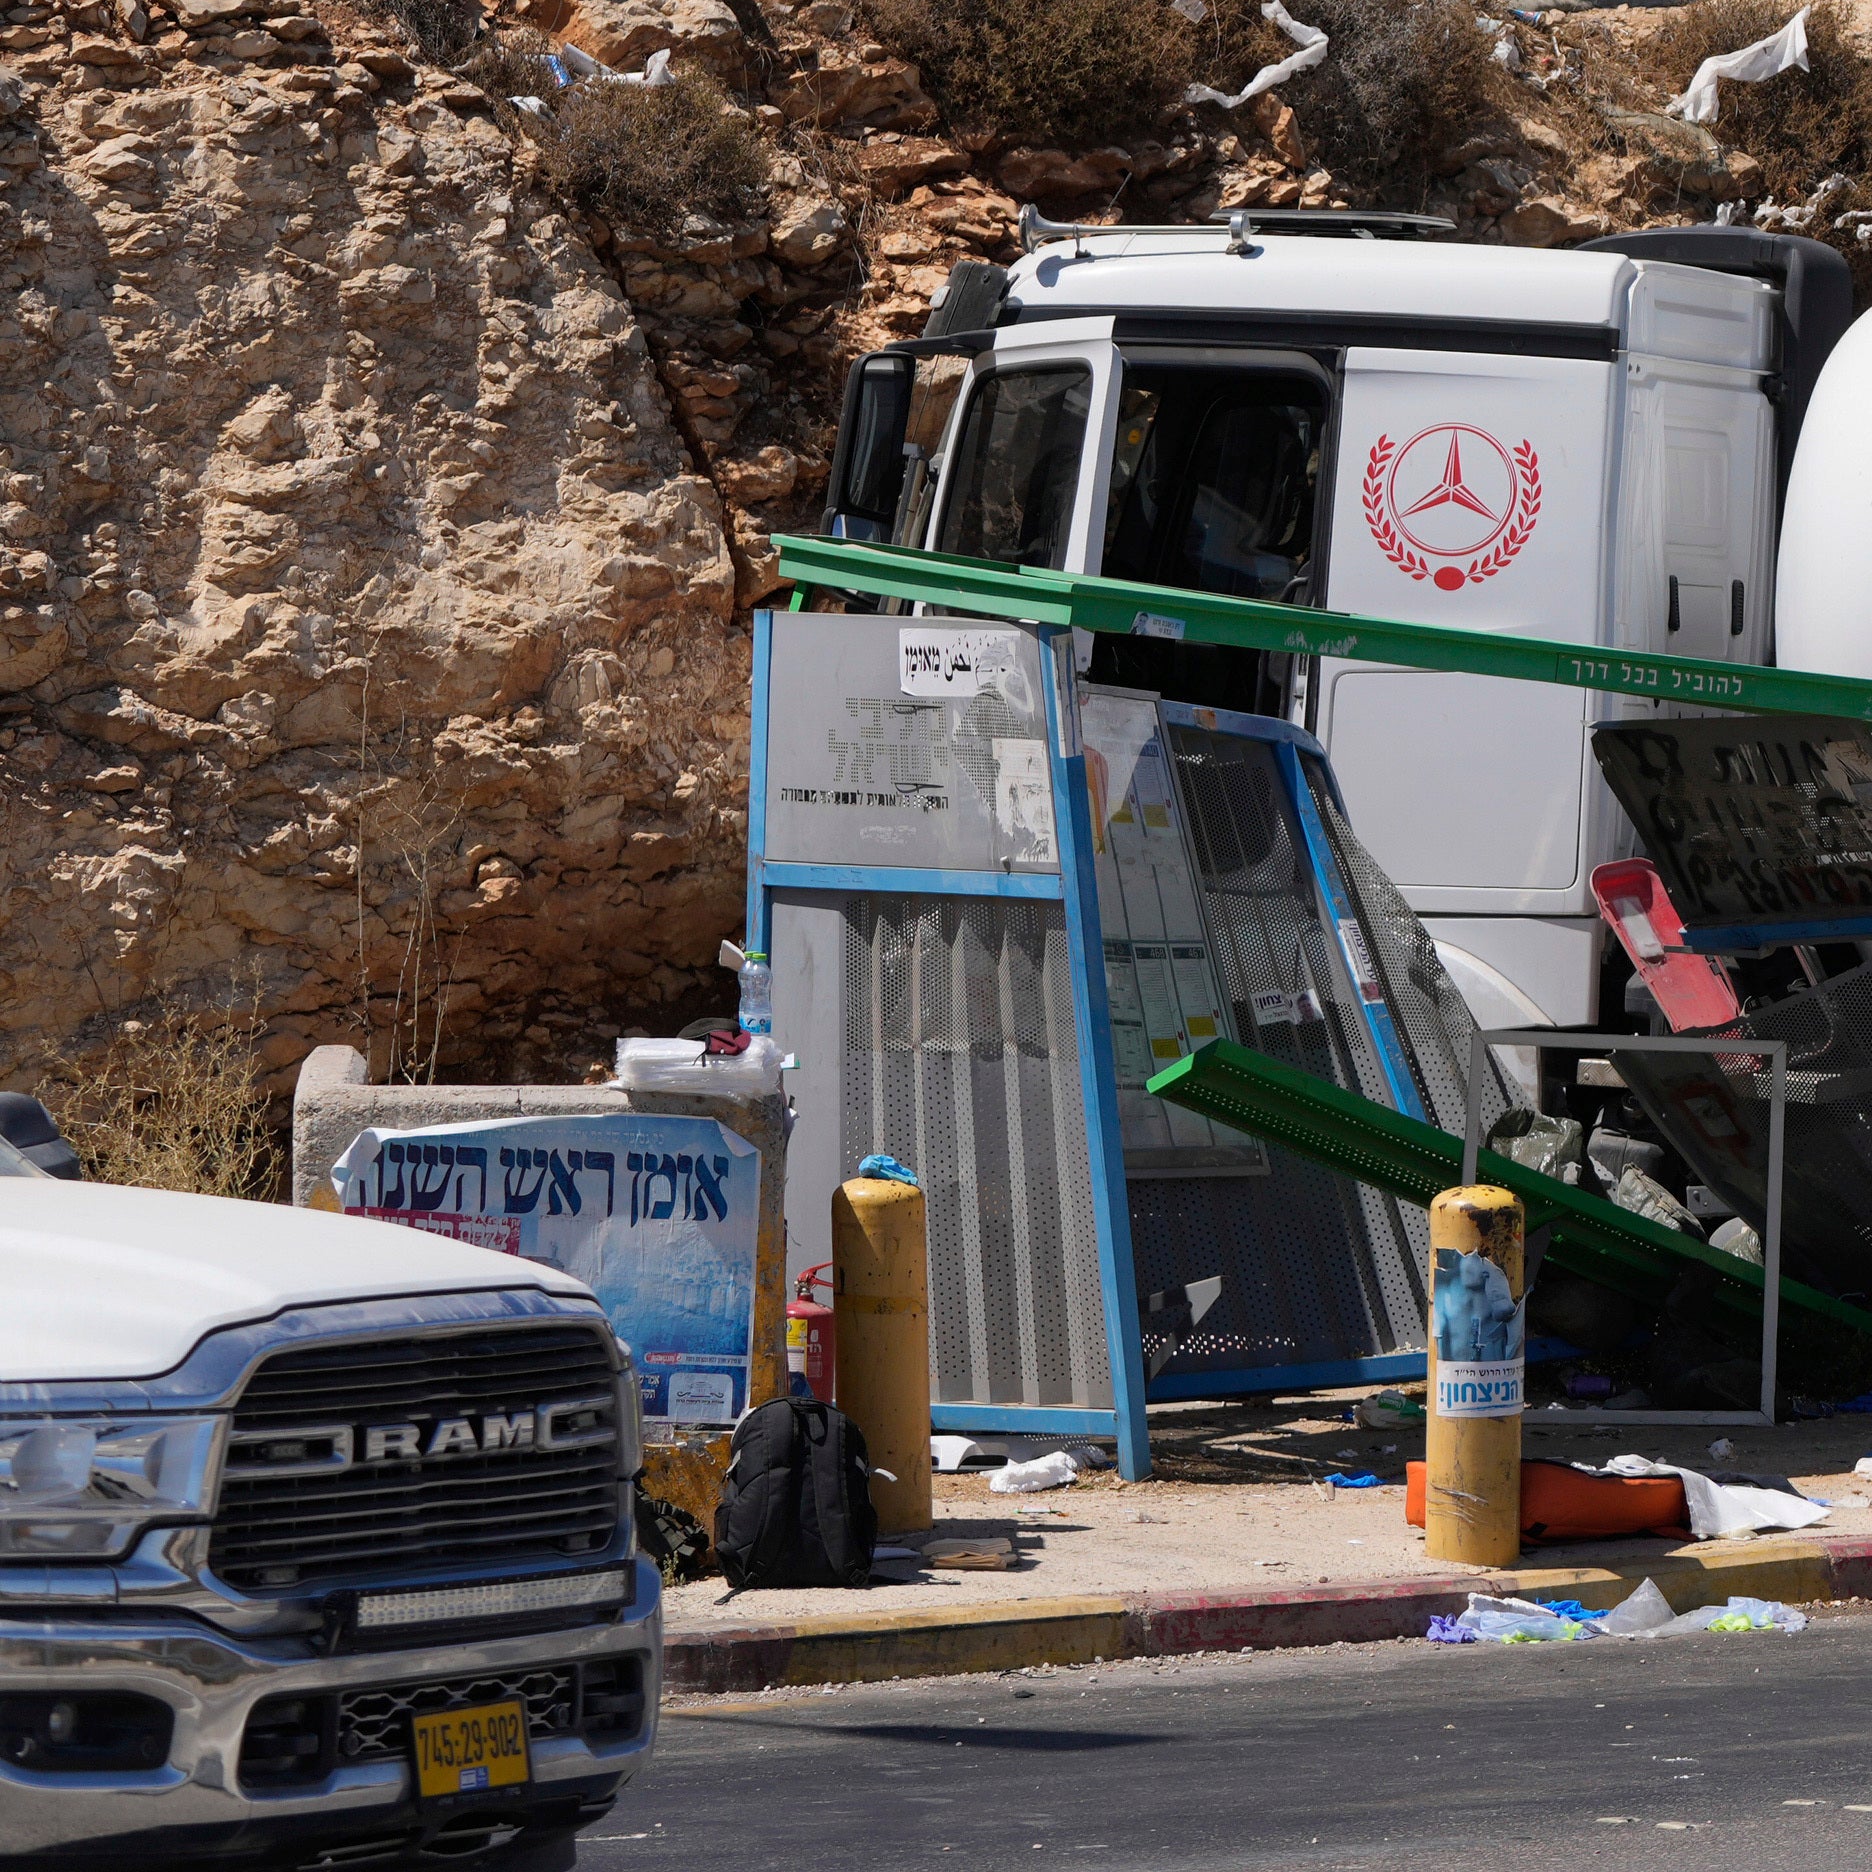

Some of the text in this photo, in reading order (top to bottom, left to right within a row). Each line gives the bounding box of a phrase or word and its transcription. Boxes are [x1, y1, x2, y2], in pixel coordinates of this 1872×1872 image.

[1571, 660, 1742, 695] להוביל בכל דרך
[828, 729, 948, 784] ישראל
[500, 1146, 616, 1217] ראש
[627, 1150, 730, 1228] אומן
[1439, 1380, 1519, 1409] הניצחון!
[365, 1411, 534, 1462] RAM
